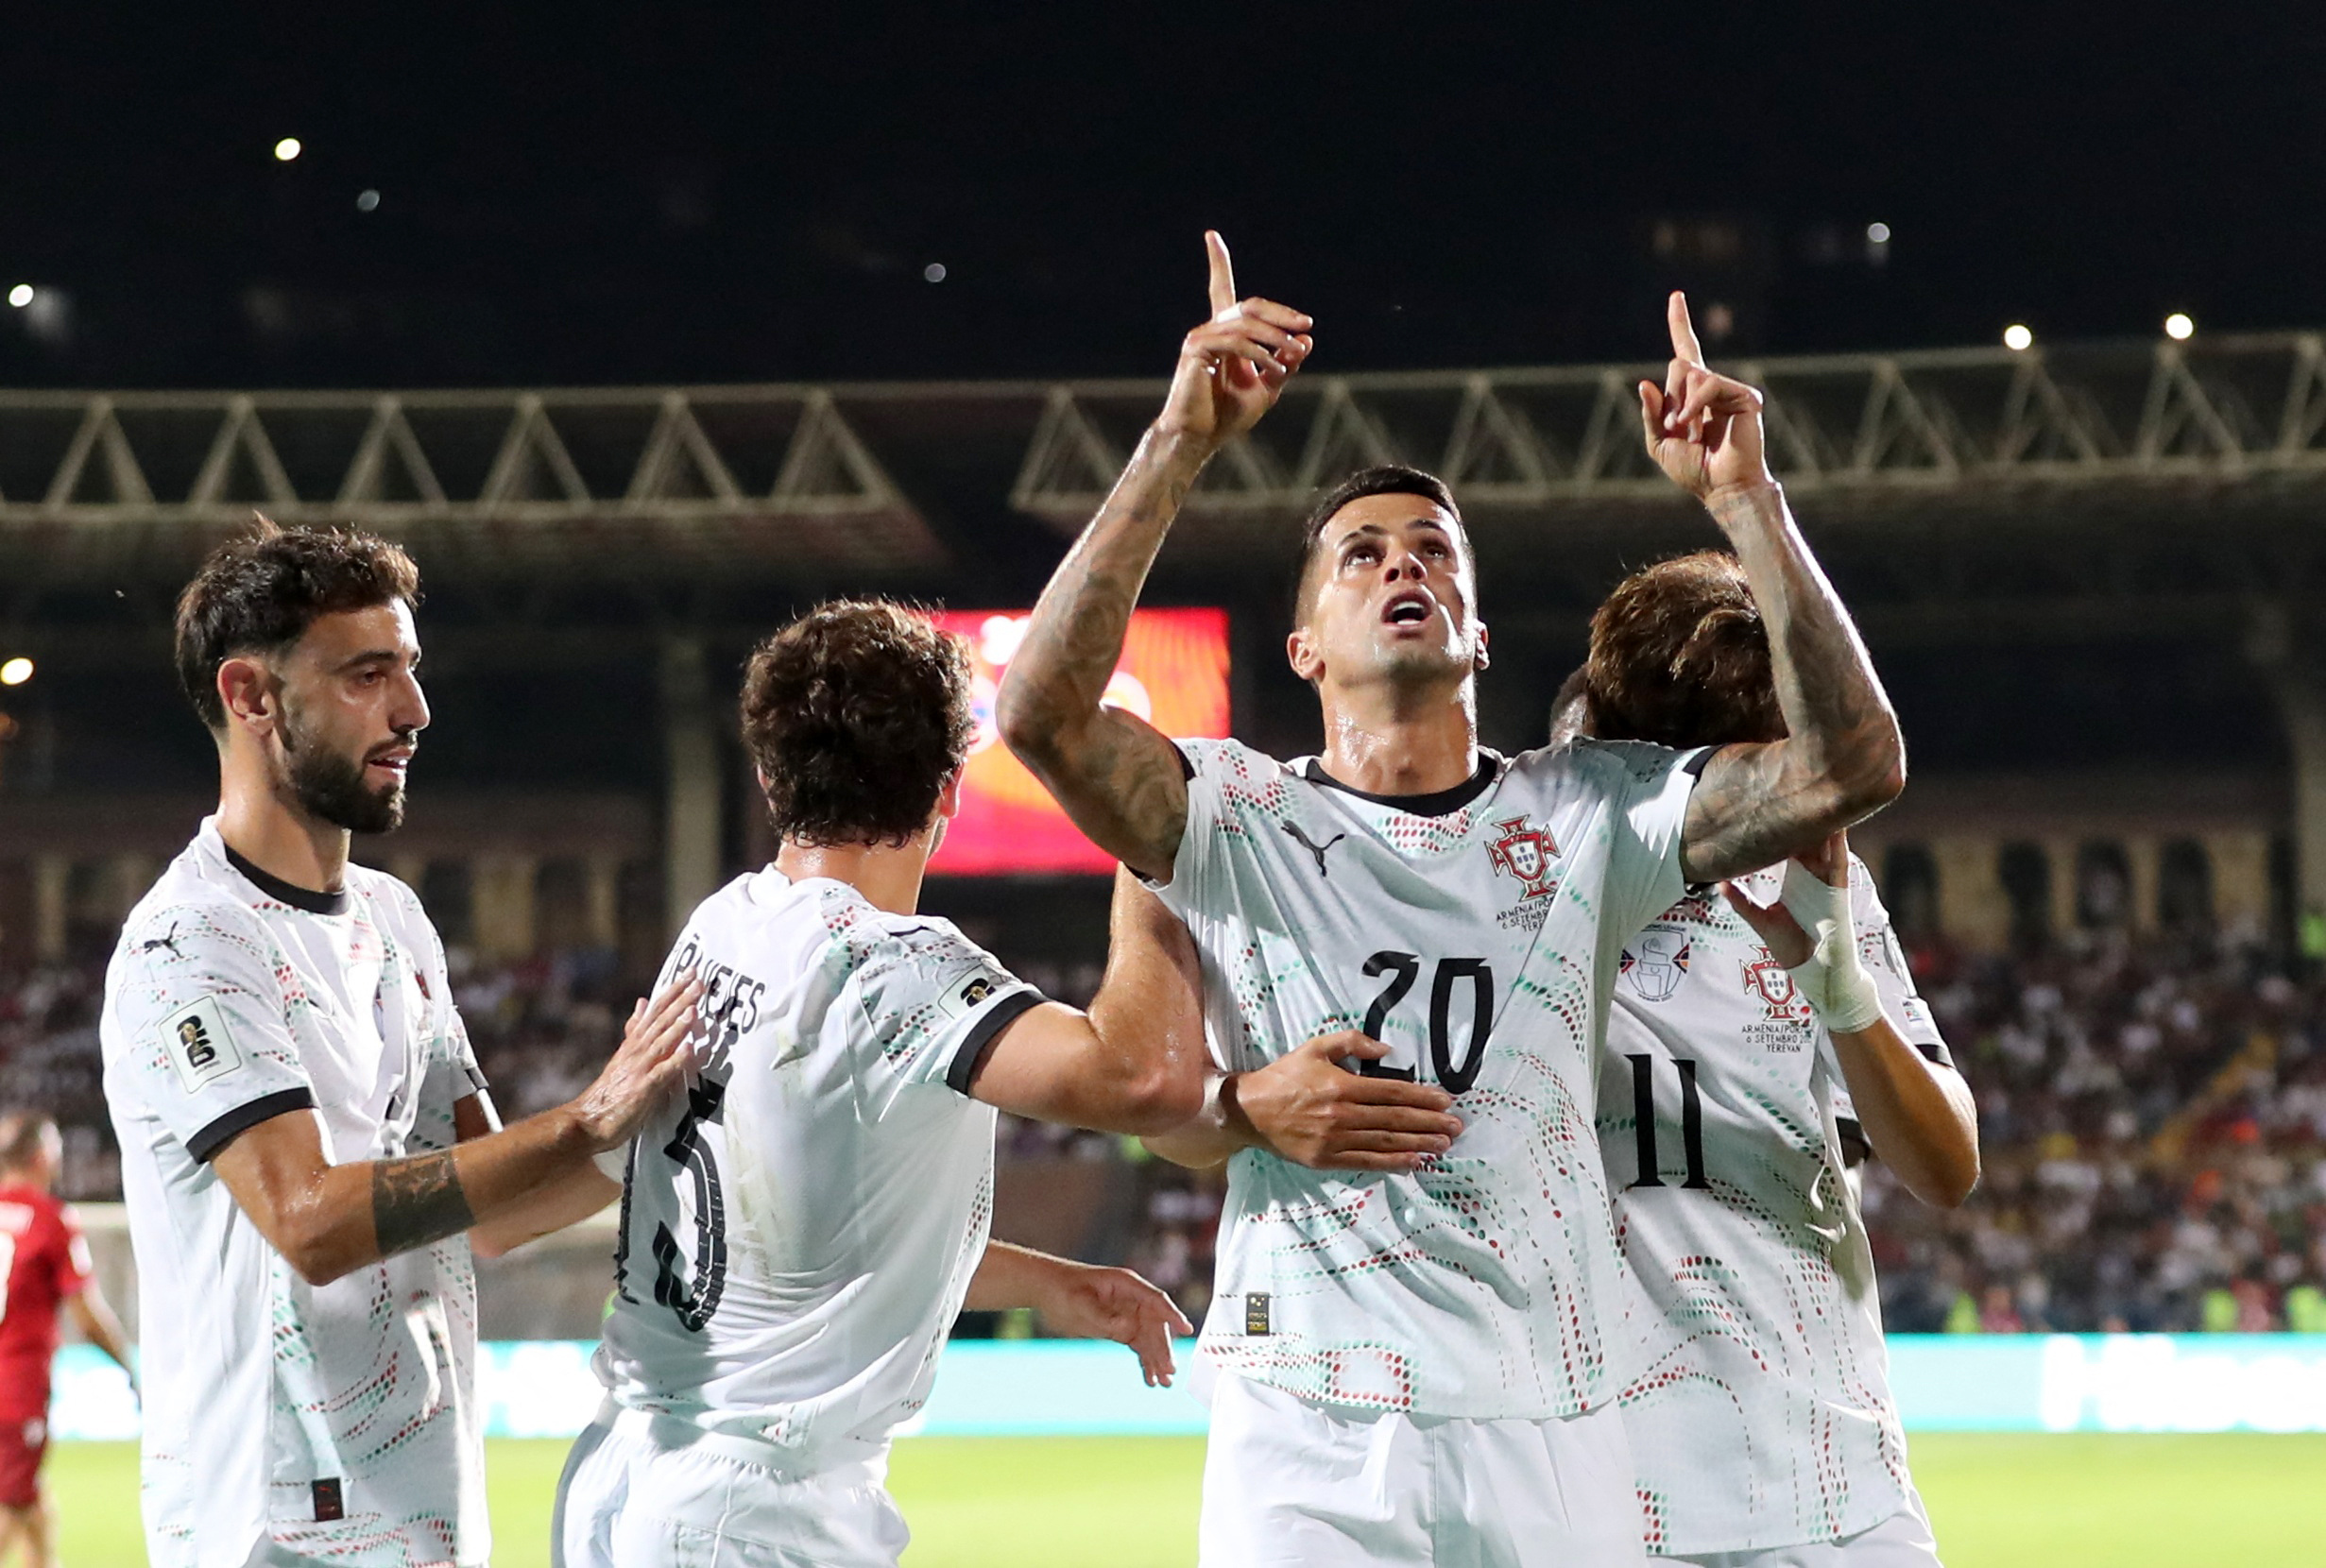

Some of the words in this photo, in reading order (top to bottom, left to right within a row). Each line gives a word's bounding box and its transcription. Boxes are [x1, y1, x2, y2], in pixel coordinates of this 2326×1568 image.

[1511, 910, 1548, 928] SETEMBR
[1361, 950, 1494, 1095] 20
[1754, 1034, 1798, 1044] SETEMBRO
[1766, 1044, 1801, 1053] YEREVAN
[1623, 1054, 1714, 1189] 11
